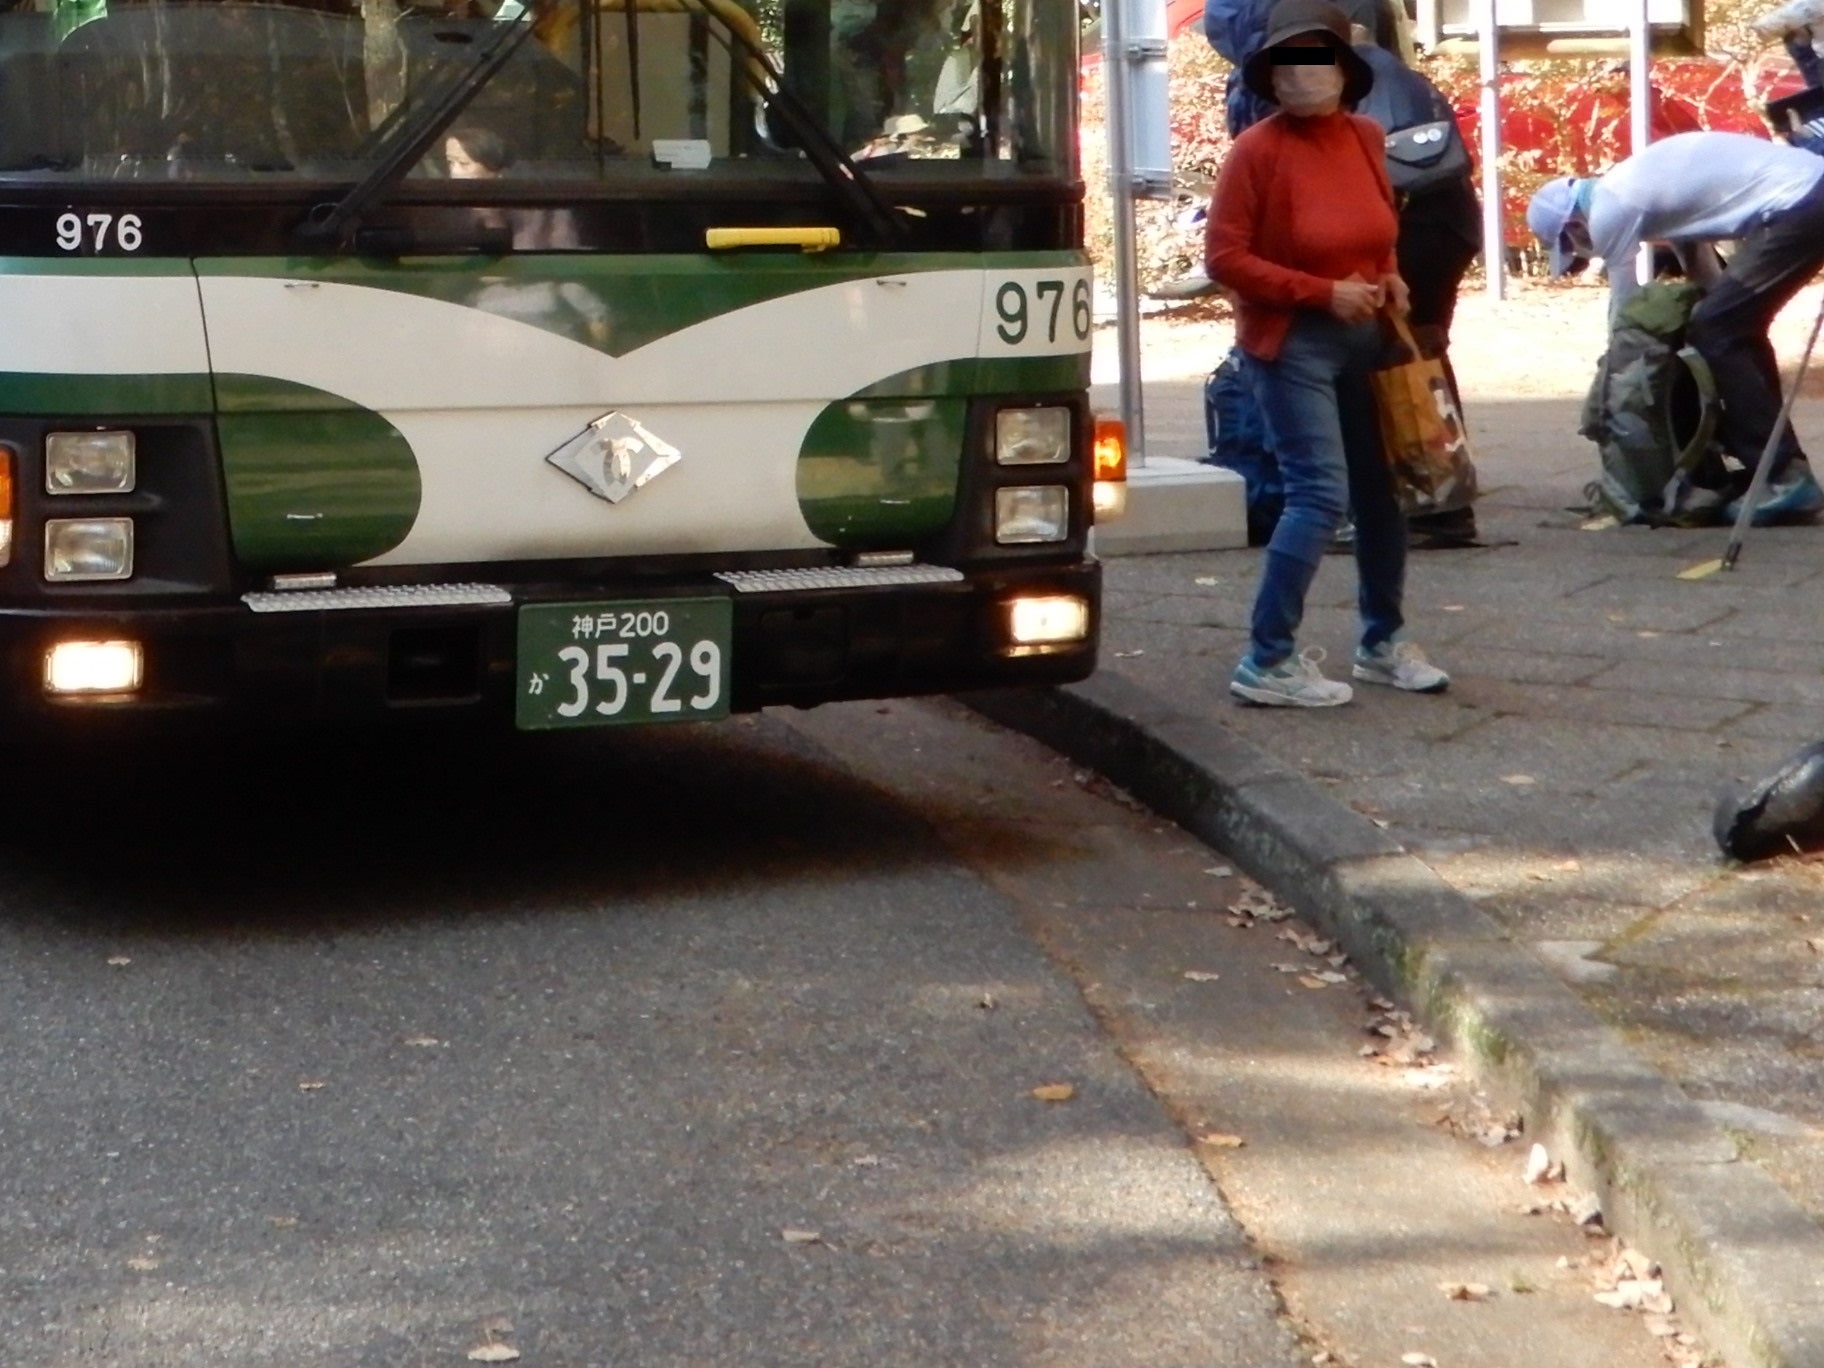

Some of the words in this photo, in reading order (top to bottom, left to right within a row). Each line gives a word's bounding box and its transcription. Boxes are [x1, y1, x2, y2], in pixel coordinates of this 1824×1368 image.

[56, 213, 142, 251] 976
[996, 279, 1090, 345] 976
[572, 611, 669, 639] 神戸200
[528, 672, 549, 695] か
[557, 640, 721, 718] 35-29
